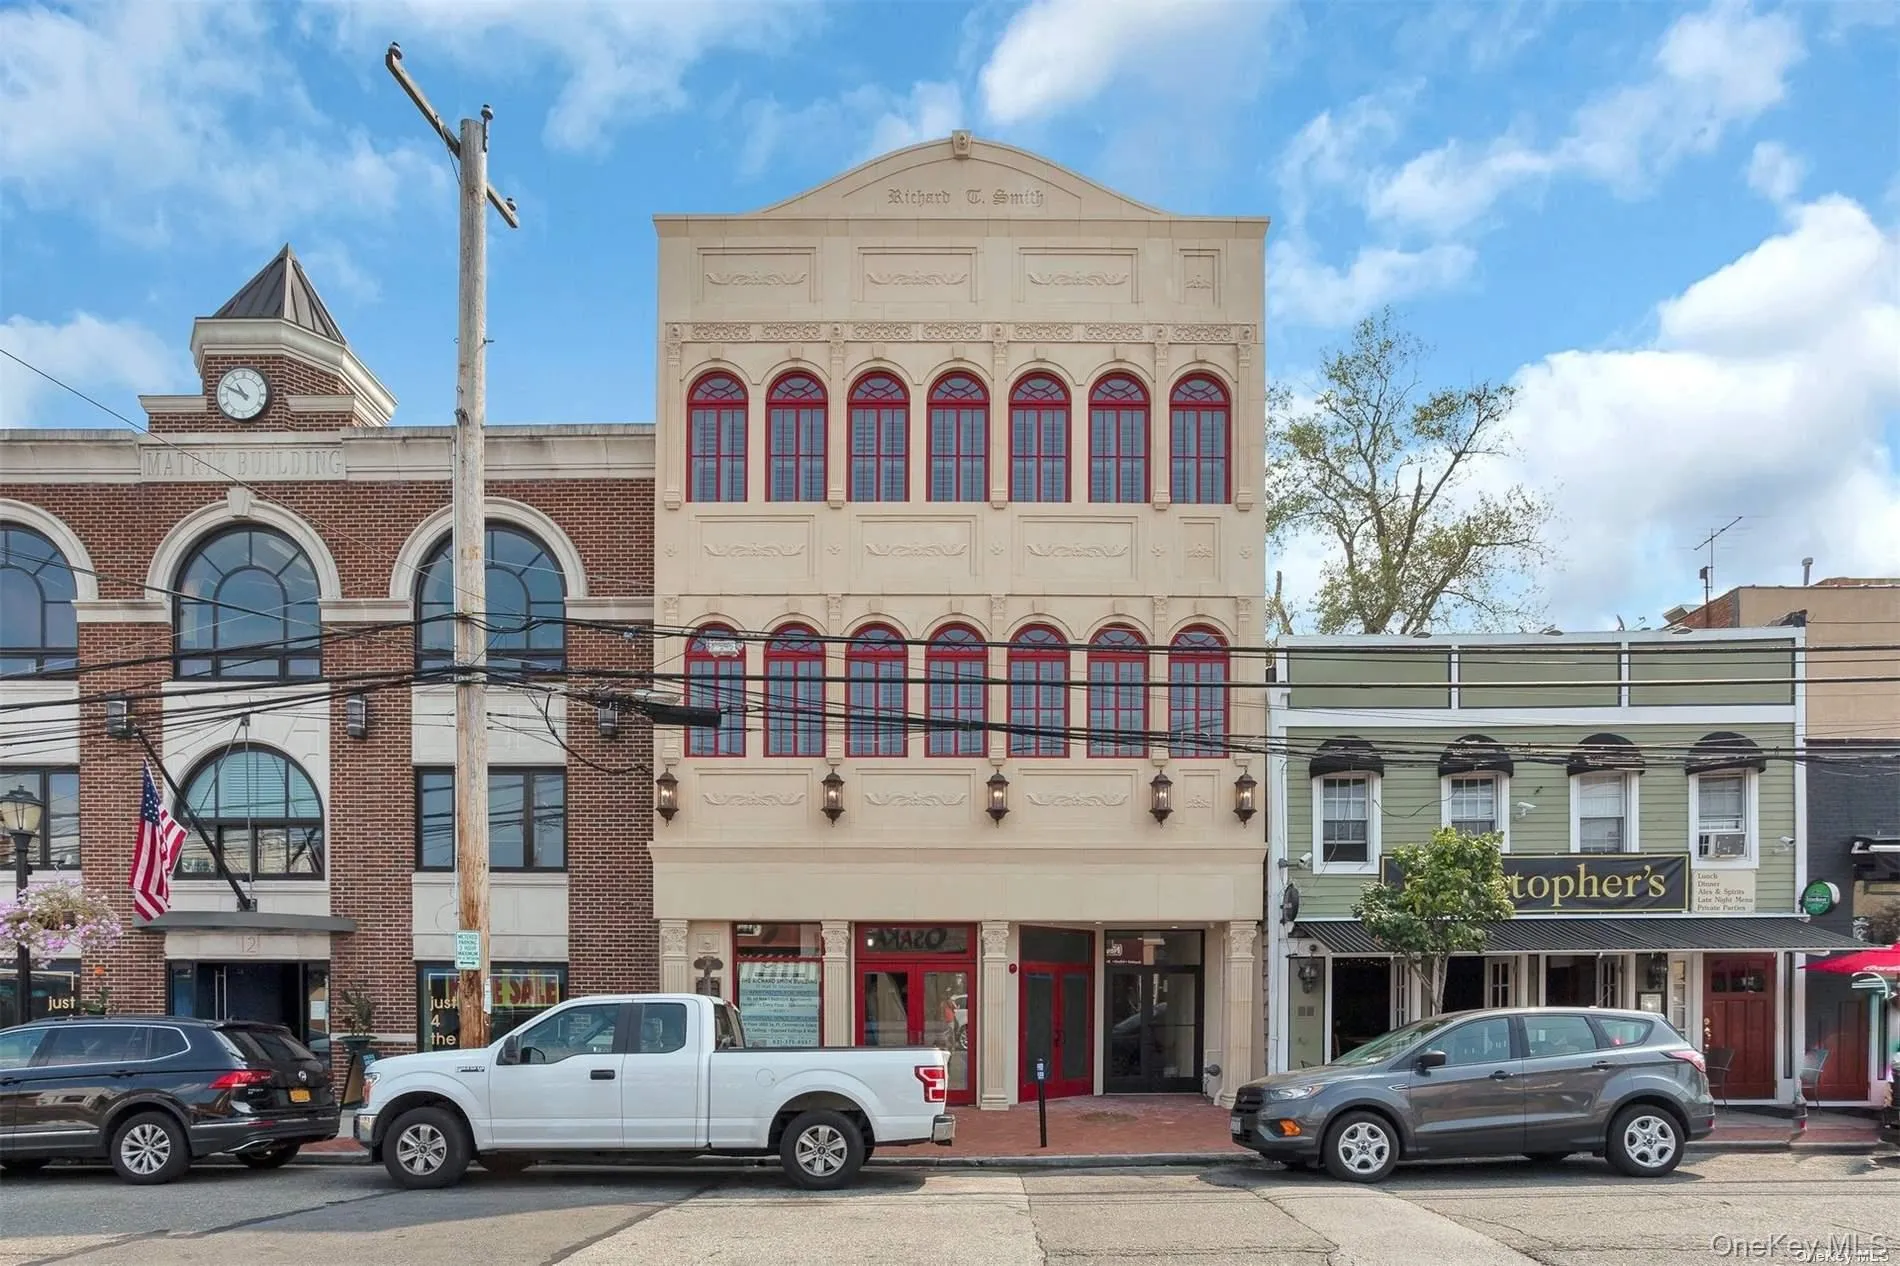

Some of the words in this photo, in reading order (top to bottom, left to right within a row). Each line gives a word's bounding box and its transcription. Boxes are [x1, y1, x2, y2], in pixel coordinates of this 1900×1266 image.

[888, 188, 951, 207] Richard
[992, 188, 1045, 208] Smith
[146, 451, 228, 476] MATRIX
[237, 450, 342, 475] BUILDING
[1697, 895, 1713, 903] Late
[1714, 895, 1733, 904] Night
[1722, 888, 1745, 897] Spirits
[509, 977, 558, 1005] SALE
[47, 995, 76, 1011] just
[430, 996, 457, 1011] just
[431, 1014, 440, 1027] 4
[431, 1032, 457, 1045] the
